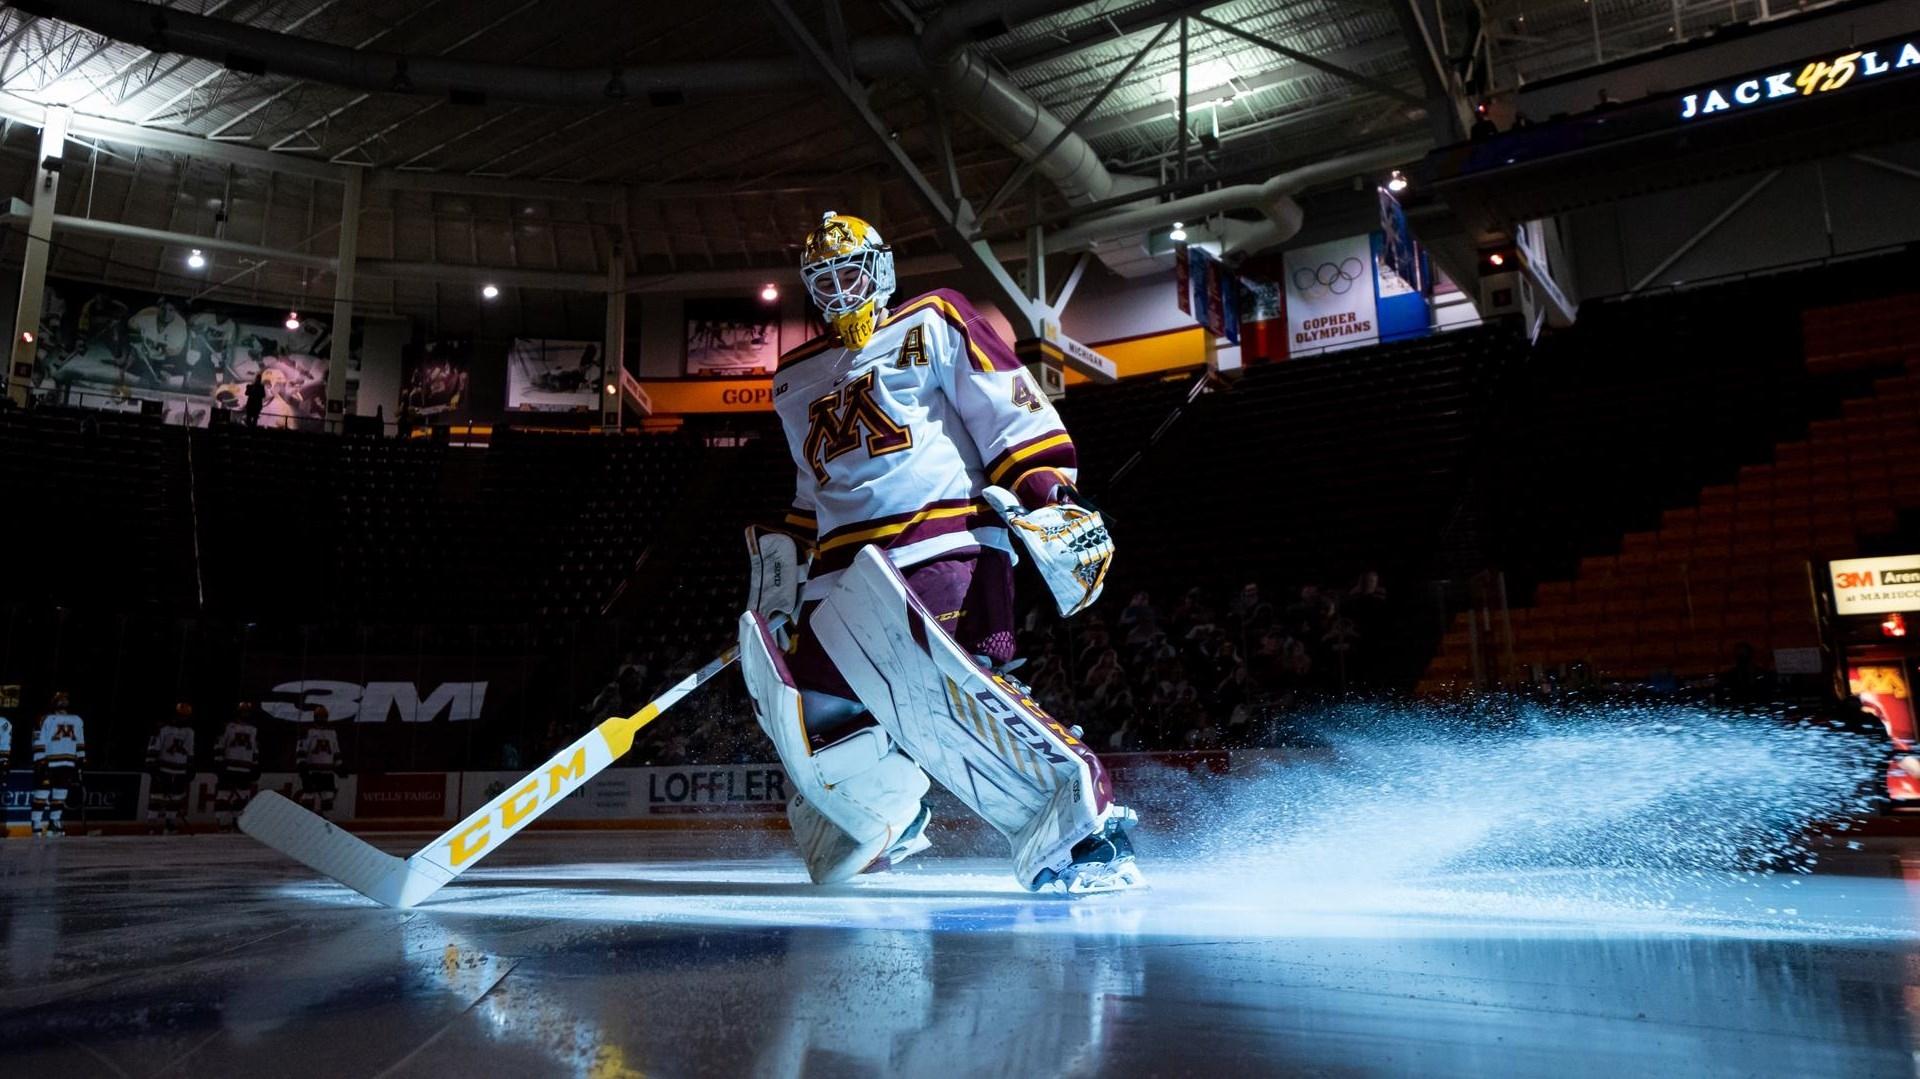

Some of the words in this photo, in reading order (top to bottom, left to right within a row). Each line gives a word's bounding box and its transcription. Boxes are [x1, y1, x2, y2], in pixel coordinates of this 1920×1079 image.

[1682, 72, 1796, 118] JACK
[1795, 51, 1862, 95] 45
[1861, 43, 1920, 76] LA
[1295, 321, 1371, 344] OLYMPIANS
[1303, 312, 1356, 331] GOPHER
[897, 322, 929, 369] A
[1068, 341, 1103, 367] MICHIGAN
[803, 371, 913, 486] M
[1836, 571, 1873, 588] 3M
[260, 679, 488, 722] 3M
[991, 675, 1079, 745] CCM
[976, 688, 1069, 764] CCM
[363, 792, 402, 801] WELLS
[403, 792, 441, 801] FARGO
[448, 746, 586, 867] CCM
[650, 770, 787, 802] LOFFLER
